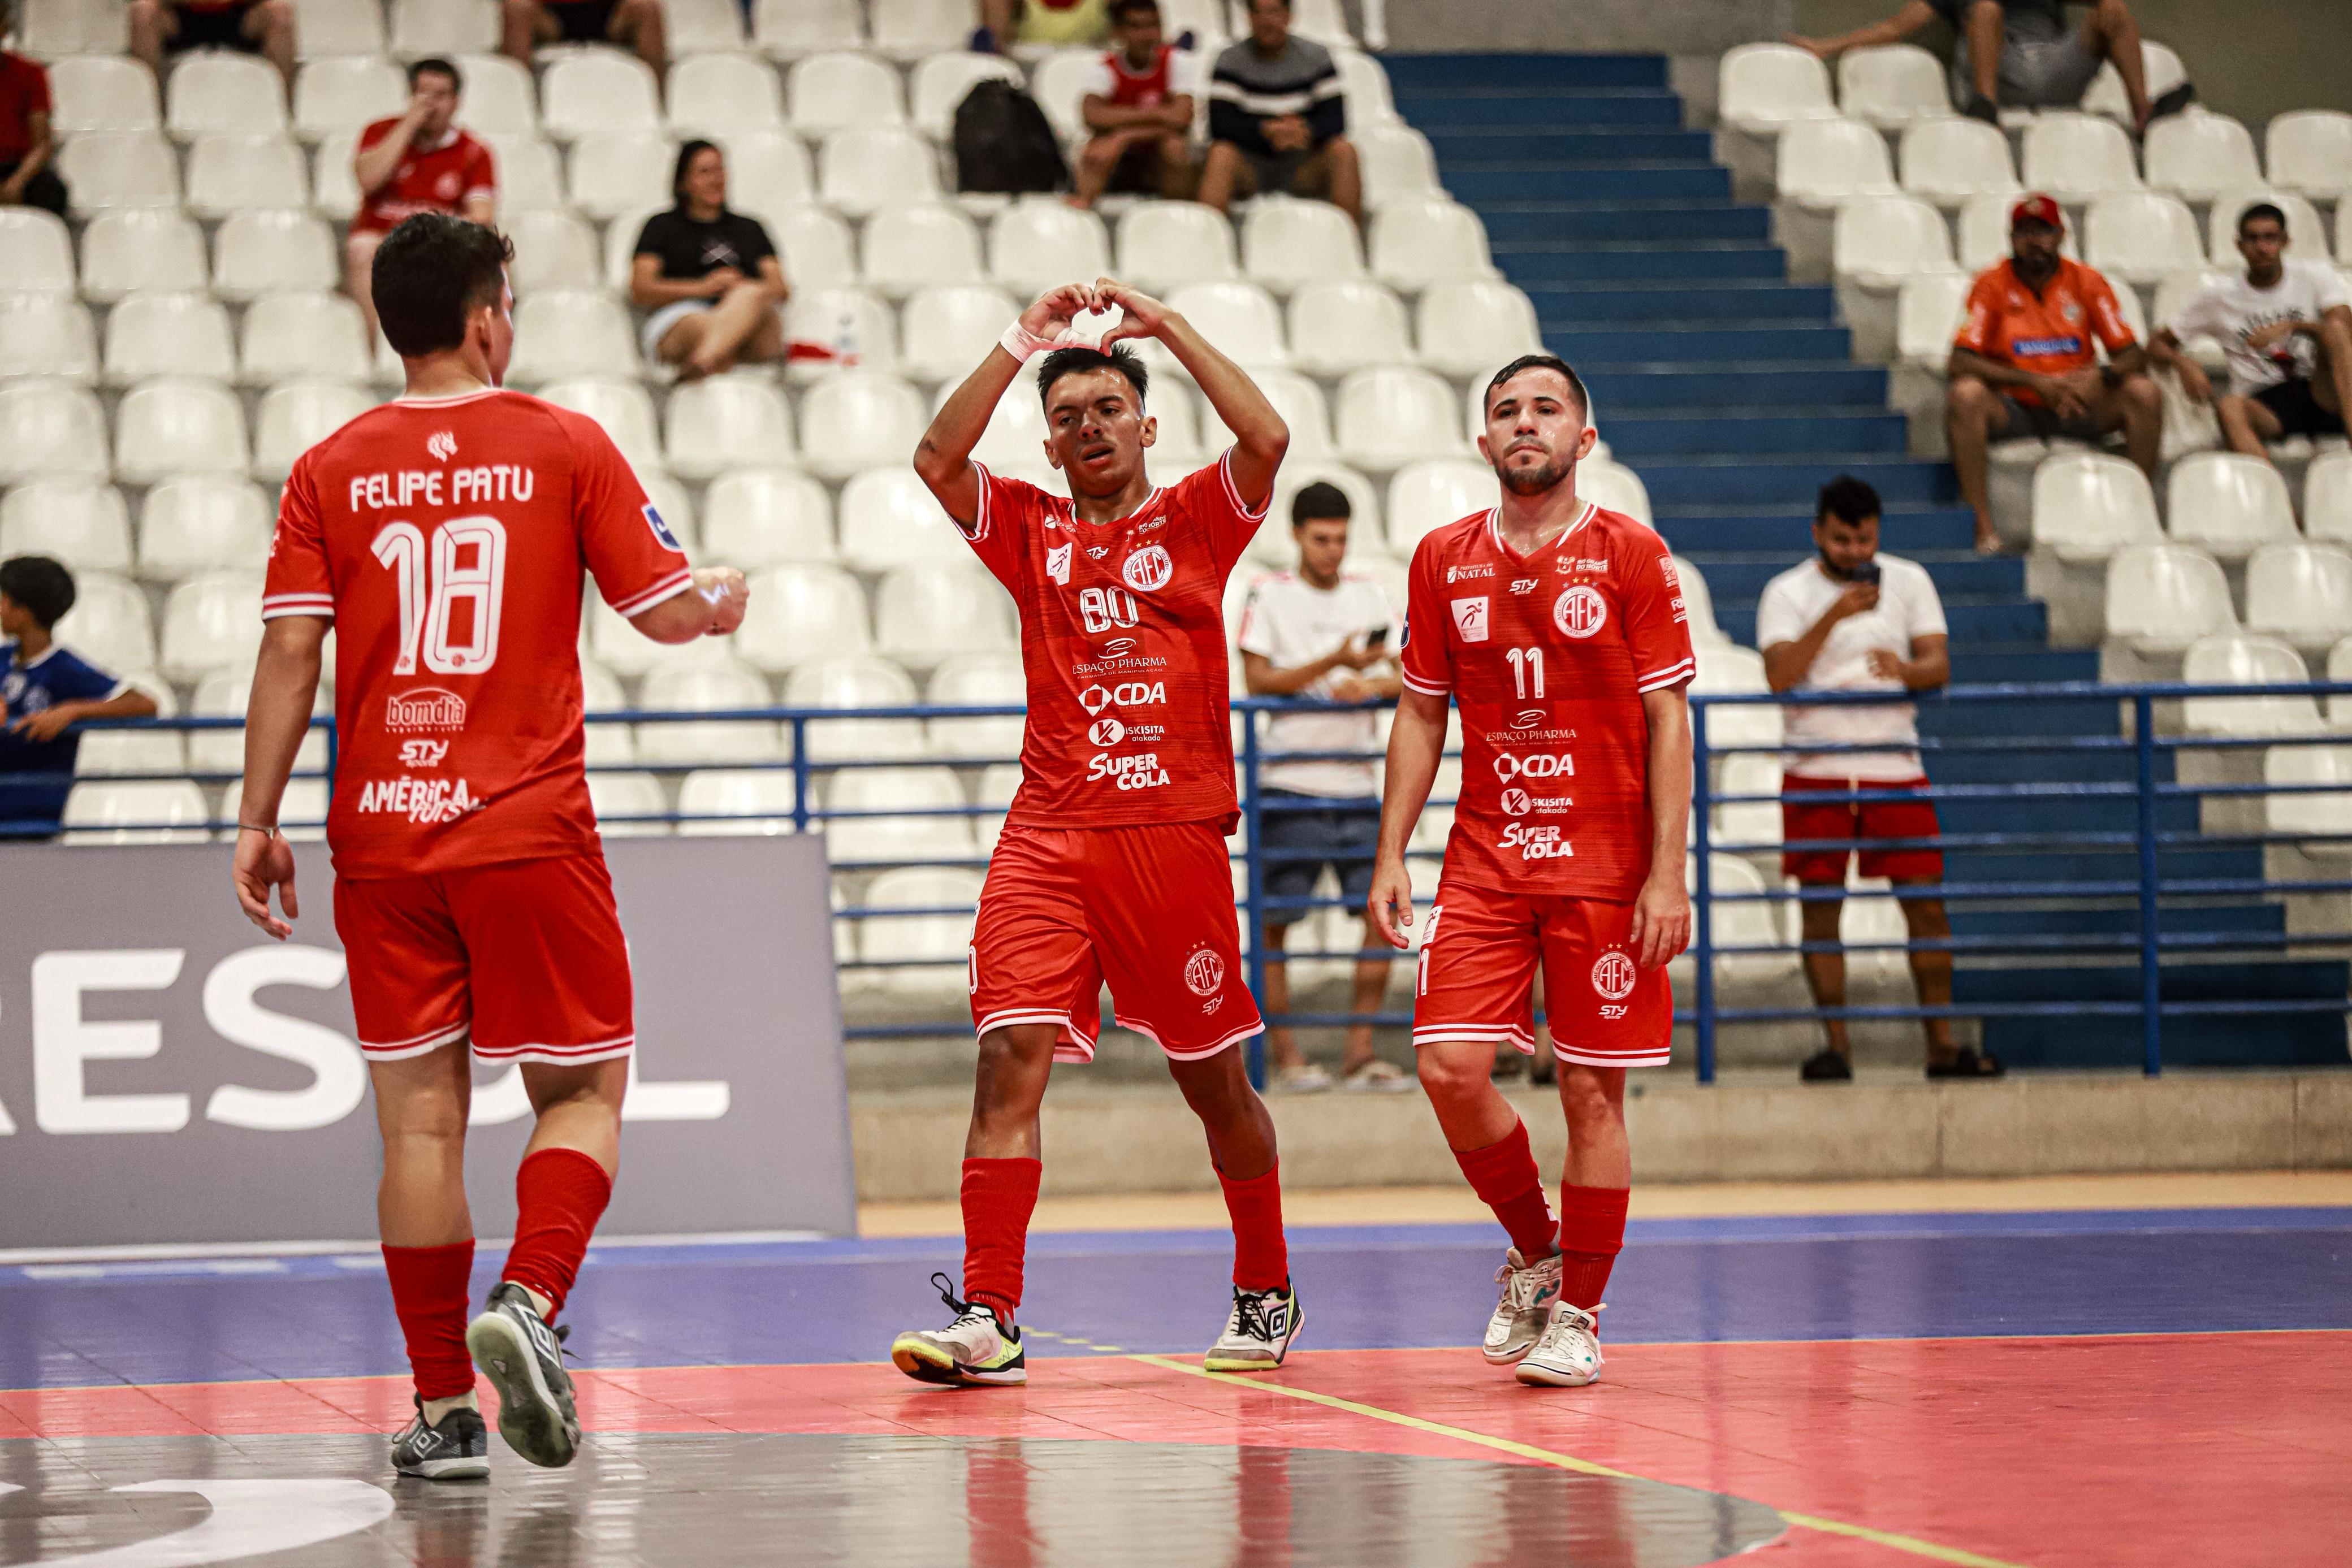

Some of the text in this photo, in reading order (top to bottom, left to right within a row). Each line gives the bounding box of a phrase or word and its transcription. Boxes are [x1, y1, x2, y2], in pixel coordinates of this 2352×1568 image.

[351, 465, 534, 512] FELIPE PATU
[1131, 552, 1164, 586] AFC
[1457, 567, 1496, 580] NATAL
[370, 515, 507, 676] 18
[1508, 578, 1539, 592] STY
[1079, 586, 1139, 633] 80
[1563, 595, 1597, 630] AFC
[1073, 657, 1168, 674] ESPAÇO PHARMA
[1506, 647, 1544, 699] 11
[1113, 682, 1166, 706] CDA
[1486, 729, 1577, 743] ESPAÇO PHARMA
[399, 739, 449, 760] STY
[1086, 752, 1159, 782] SUPER
[1521, 753, 1575, 777] CDA
[1117, 769, 1171, 791] COLA
[1497, 822, 1561, 848] SUPER
[1522, 841, 1574, 860] COLA
[1192, 956, 1218, 989] AFC
[1599, 959, 1628, 992] AFC
[1598, 1004, 1628, 1016] STY
